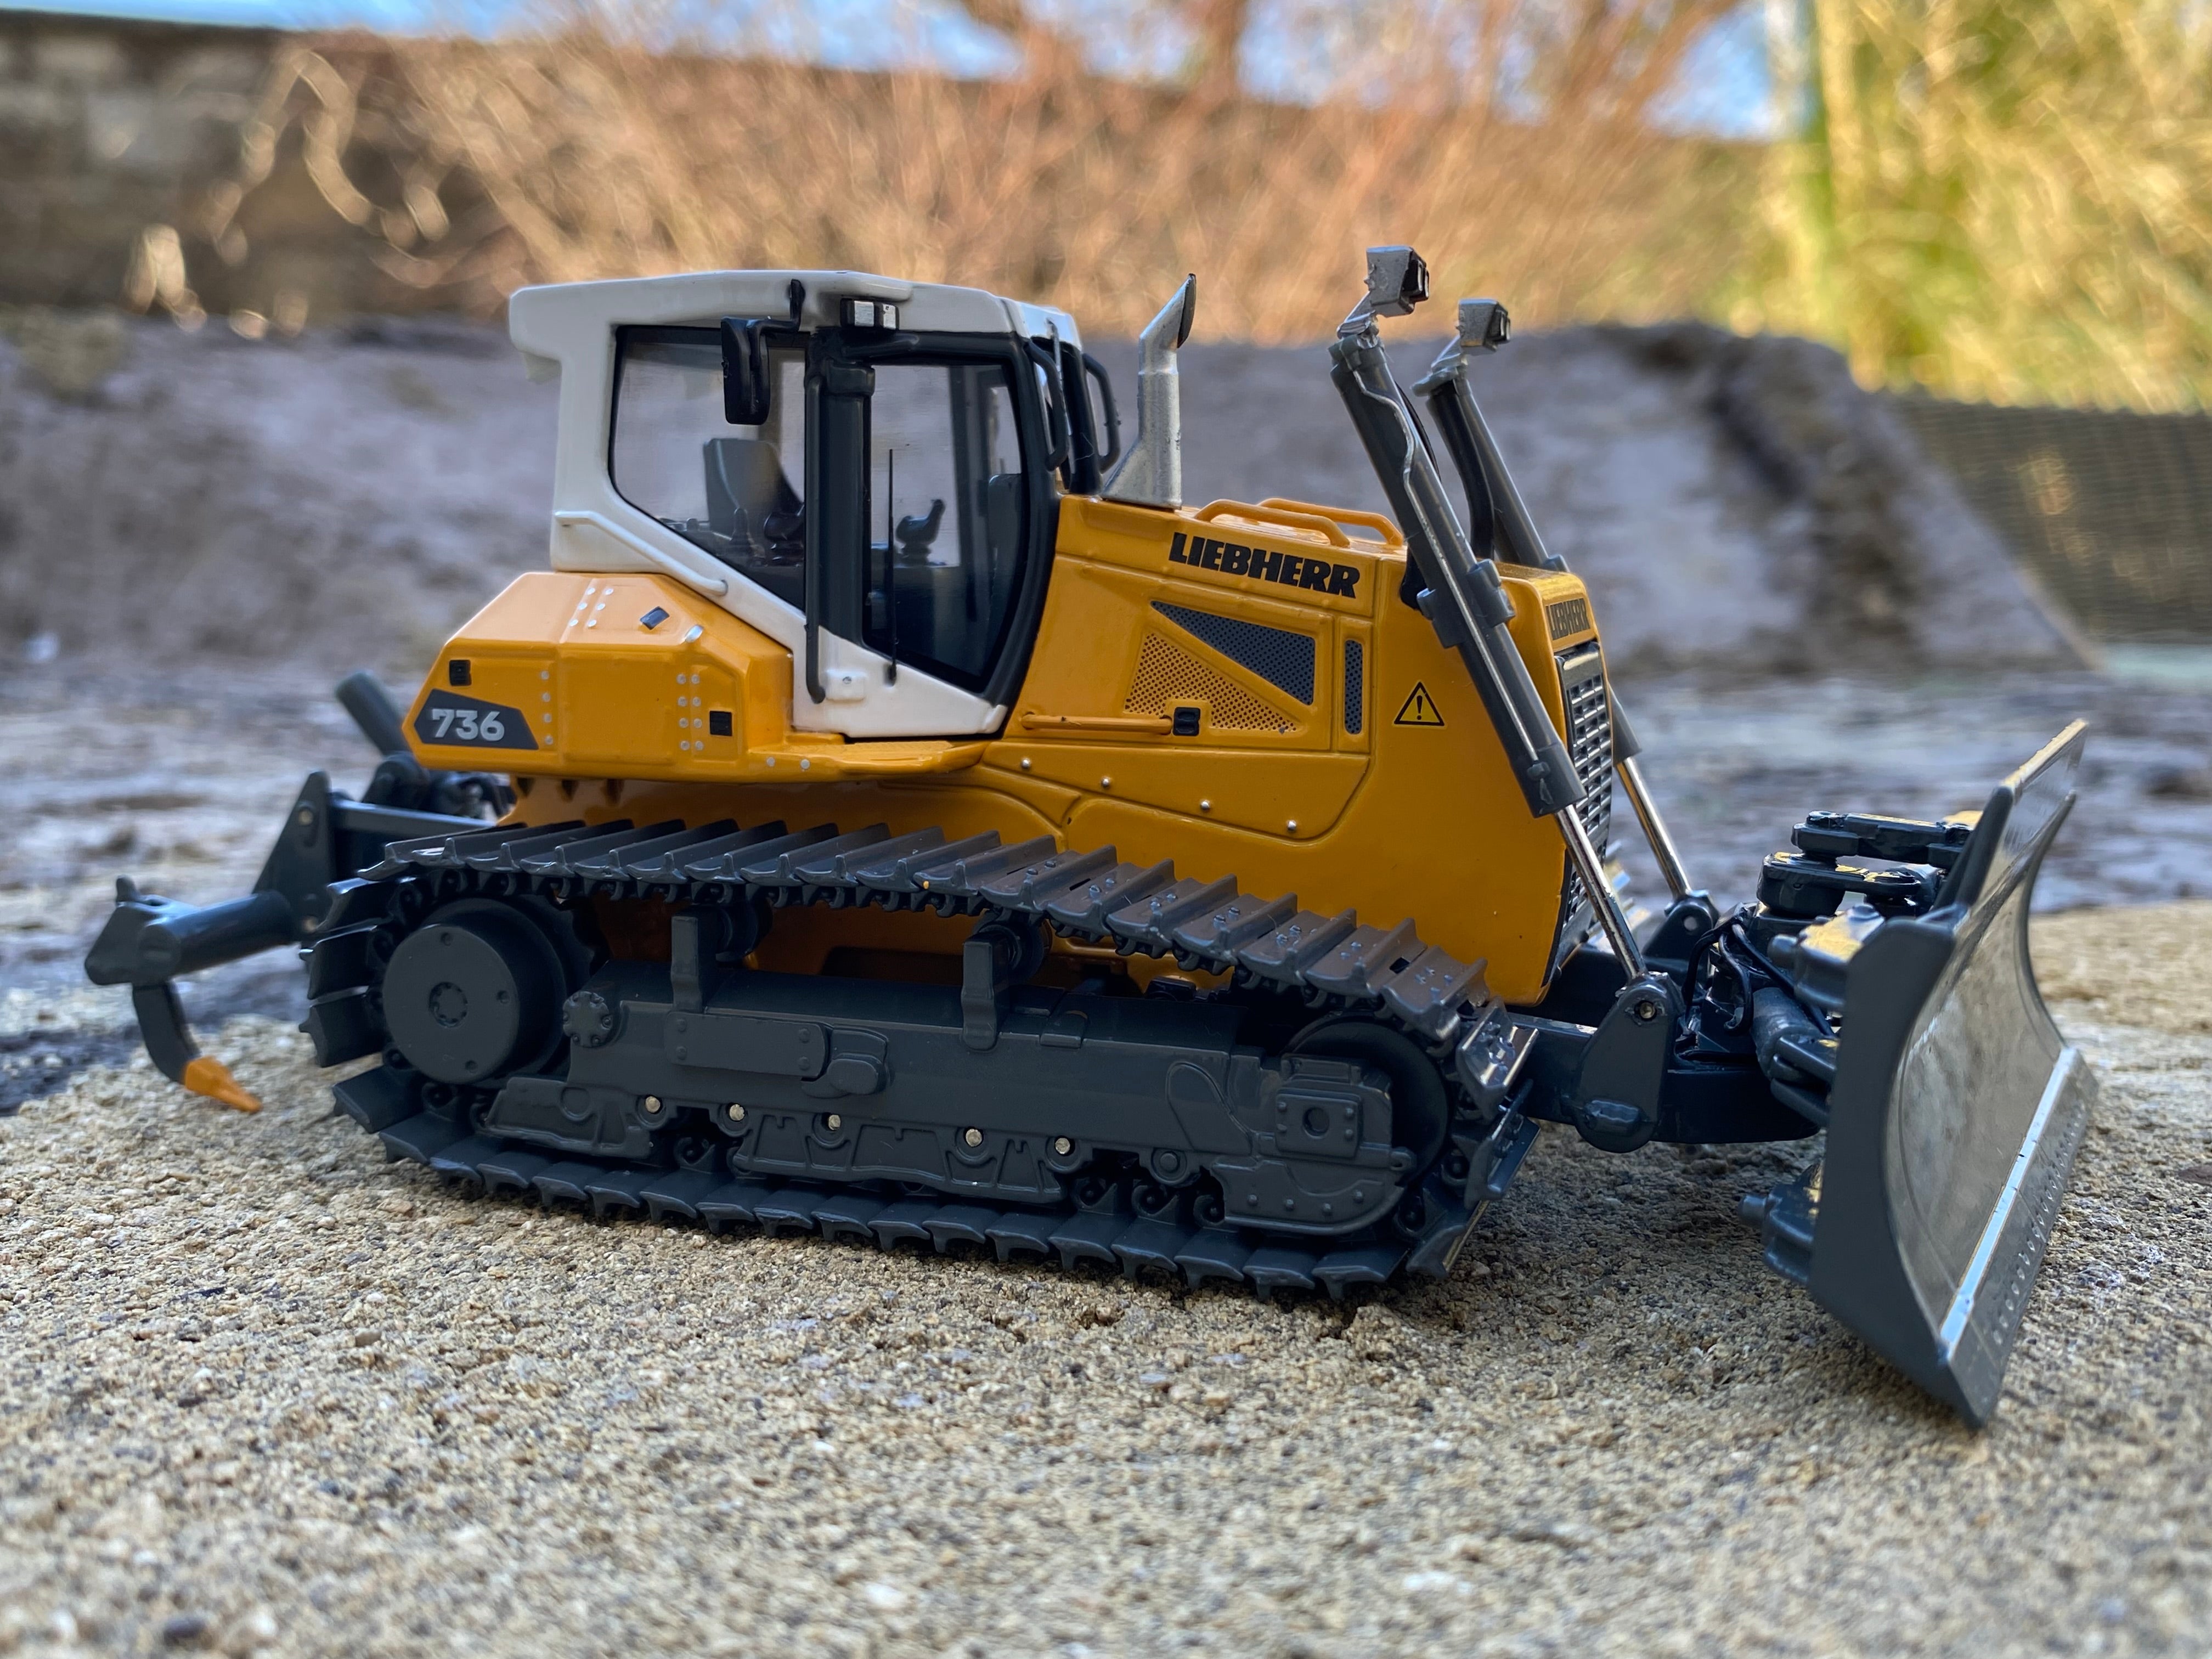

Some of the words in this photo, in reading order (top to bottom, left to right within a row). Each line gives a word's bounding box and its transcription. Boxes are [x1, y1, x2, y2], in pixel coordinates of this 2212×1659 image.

[1169, 532, 1360, 599] LIEBHERR
[1545, 597, 1590, 641] LIEBHERR
[432, 708, 505, 741] 736
